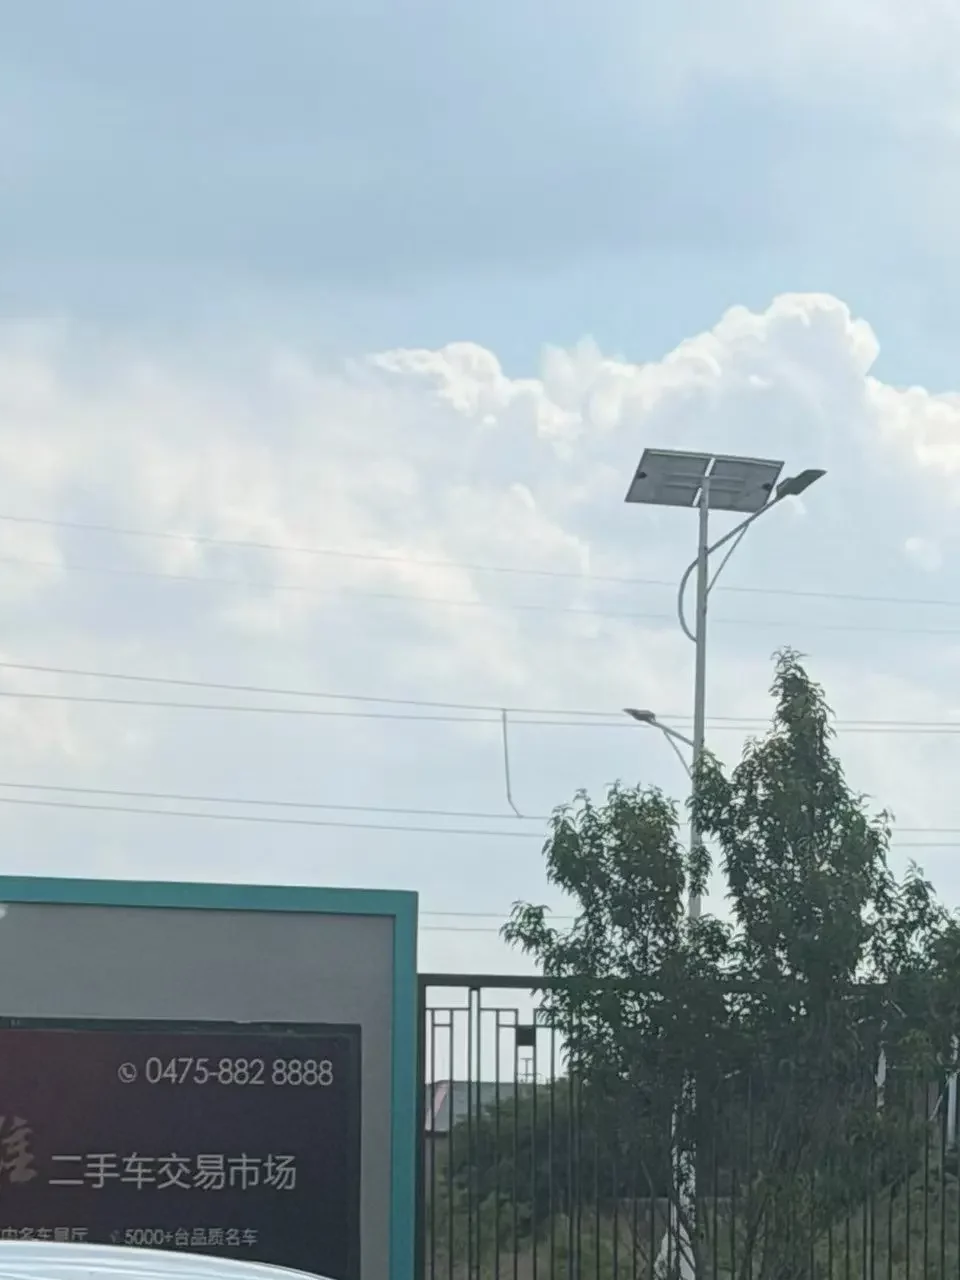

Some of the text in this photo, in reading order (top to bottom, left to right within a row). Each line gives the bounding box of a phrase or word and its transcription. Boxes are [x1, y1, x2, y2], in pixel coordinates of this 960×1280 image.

[145, 1057, 334, 1086] 0475-882 8888
[48, 1152, 297, 1190] 二手车交易市场
[124, 1227, 259, 1247] 5000+台品质名车
